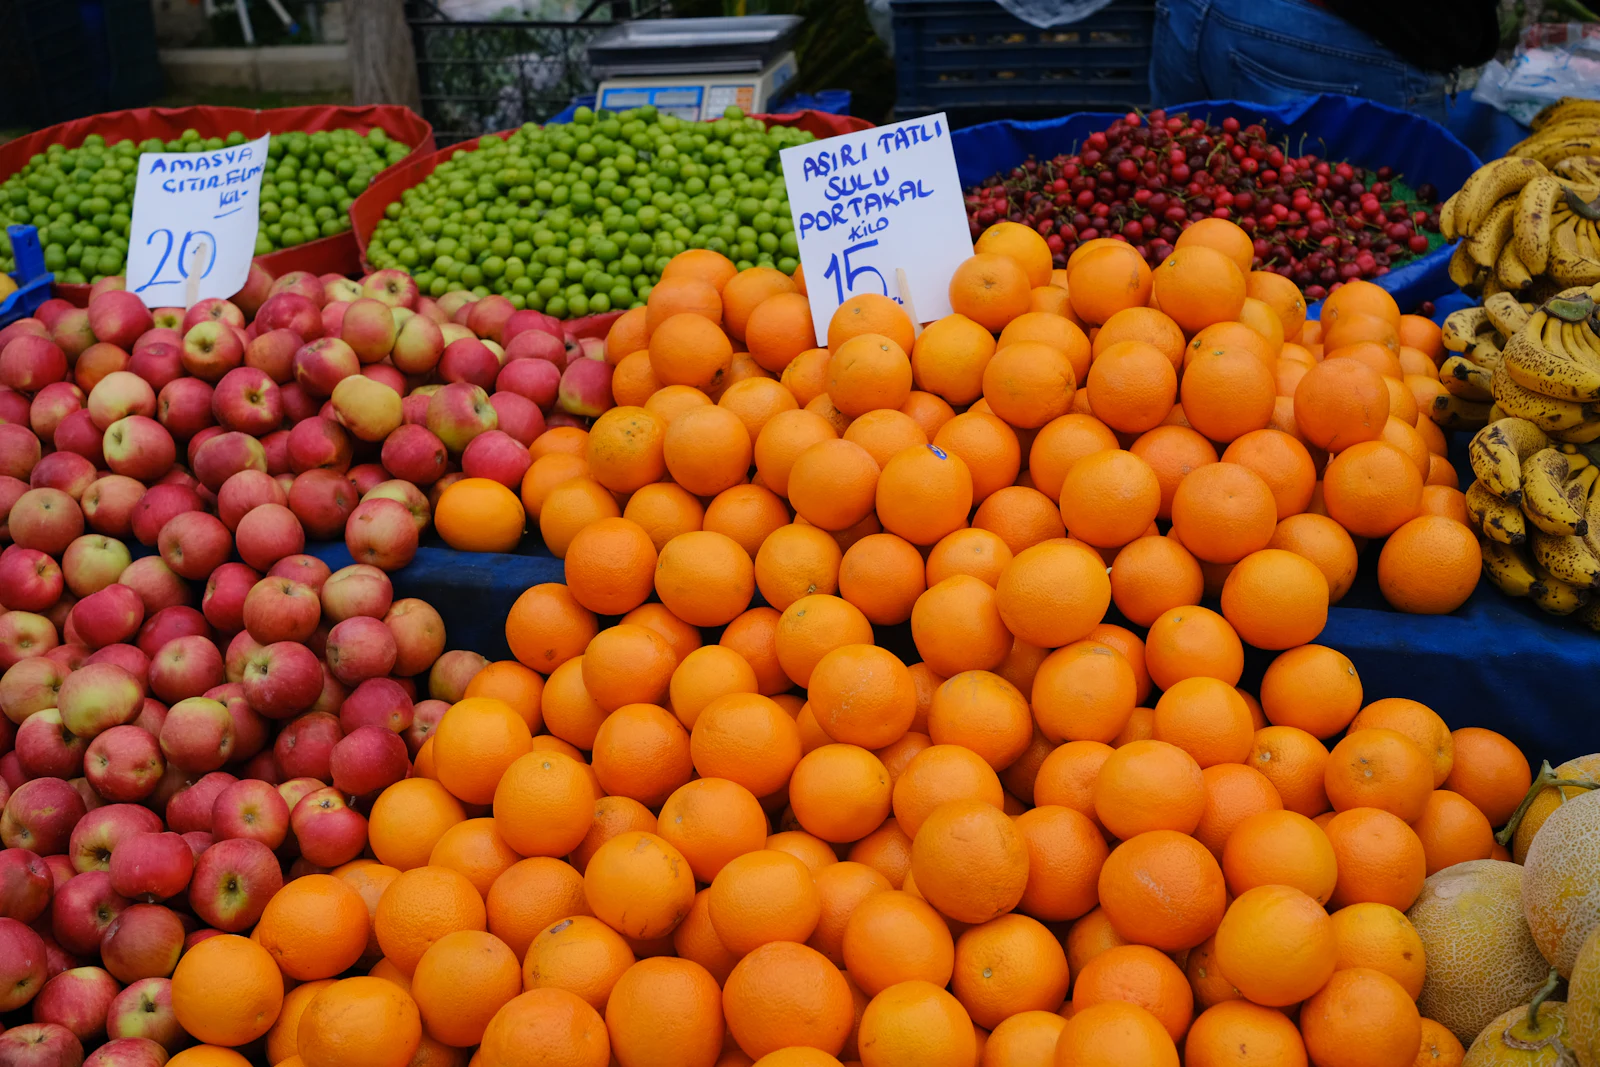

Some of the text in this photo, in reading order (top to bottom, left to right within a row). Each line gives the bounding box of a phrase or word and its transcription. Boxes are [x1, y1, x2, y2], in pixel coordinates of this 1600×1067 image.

[150, 147, 253, 174] AMASYA
[877, 120, 942, 154] TATLI
[824, 166, 890, 201] SULU
[799, 179, 935, 240] PORTAKAL
[134, 228, 217, 293] 20
[823, 239, 888, 306] 15
